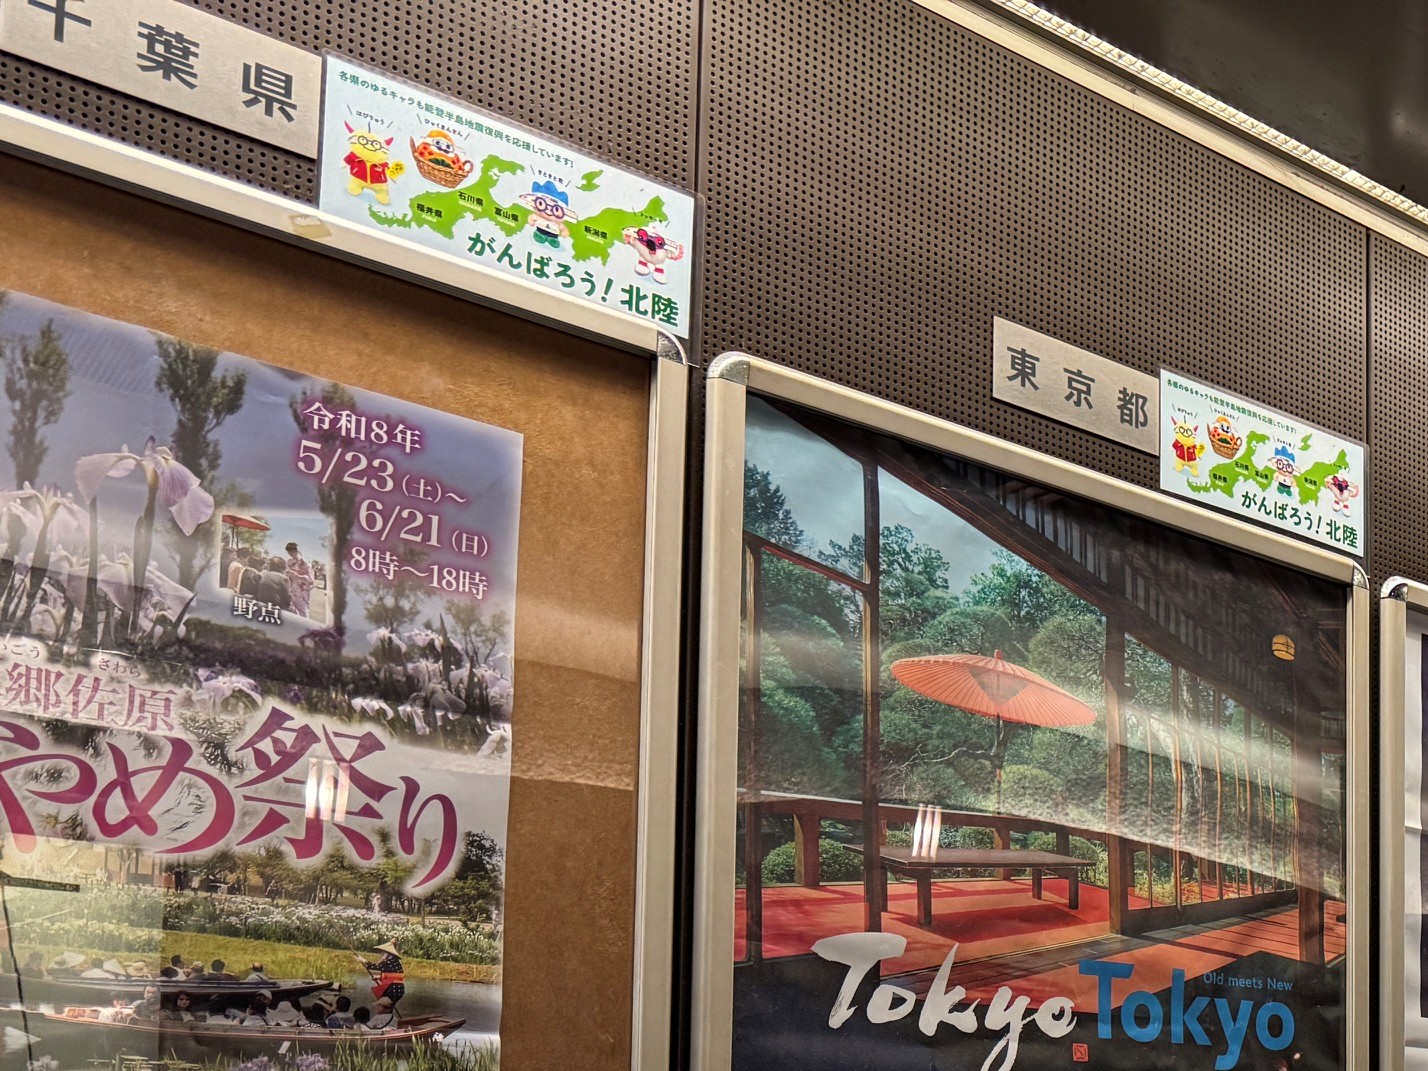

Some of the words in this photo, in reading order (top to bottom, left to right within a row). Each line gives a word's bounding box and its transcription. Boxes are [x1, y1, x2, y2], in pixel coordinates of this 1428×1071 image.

[338, 70, 575, 169] 各県のゆるキャラも能登半島地震復興を応援しています!
[416, 202, 443, 219] 福井県
[457, 190, 485, 208] 石川県
[494, 206, 520, 222] 富山県
[1006, 346, 1150, 430] 東京都
[303, 401, 422, 454] 令和8年
[350, 546, 490, 601] 8時〜18時
[232, 594, 283, 625] 野点
[98, 656, 142, 679] さわら
[1202, 972, 1224, 986] Old
[1228, 974, 1263, 990] meets
[1267, 977, 1293, 992] New
[1078, 958, 1296, 1071] Tokyo
